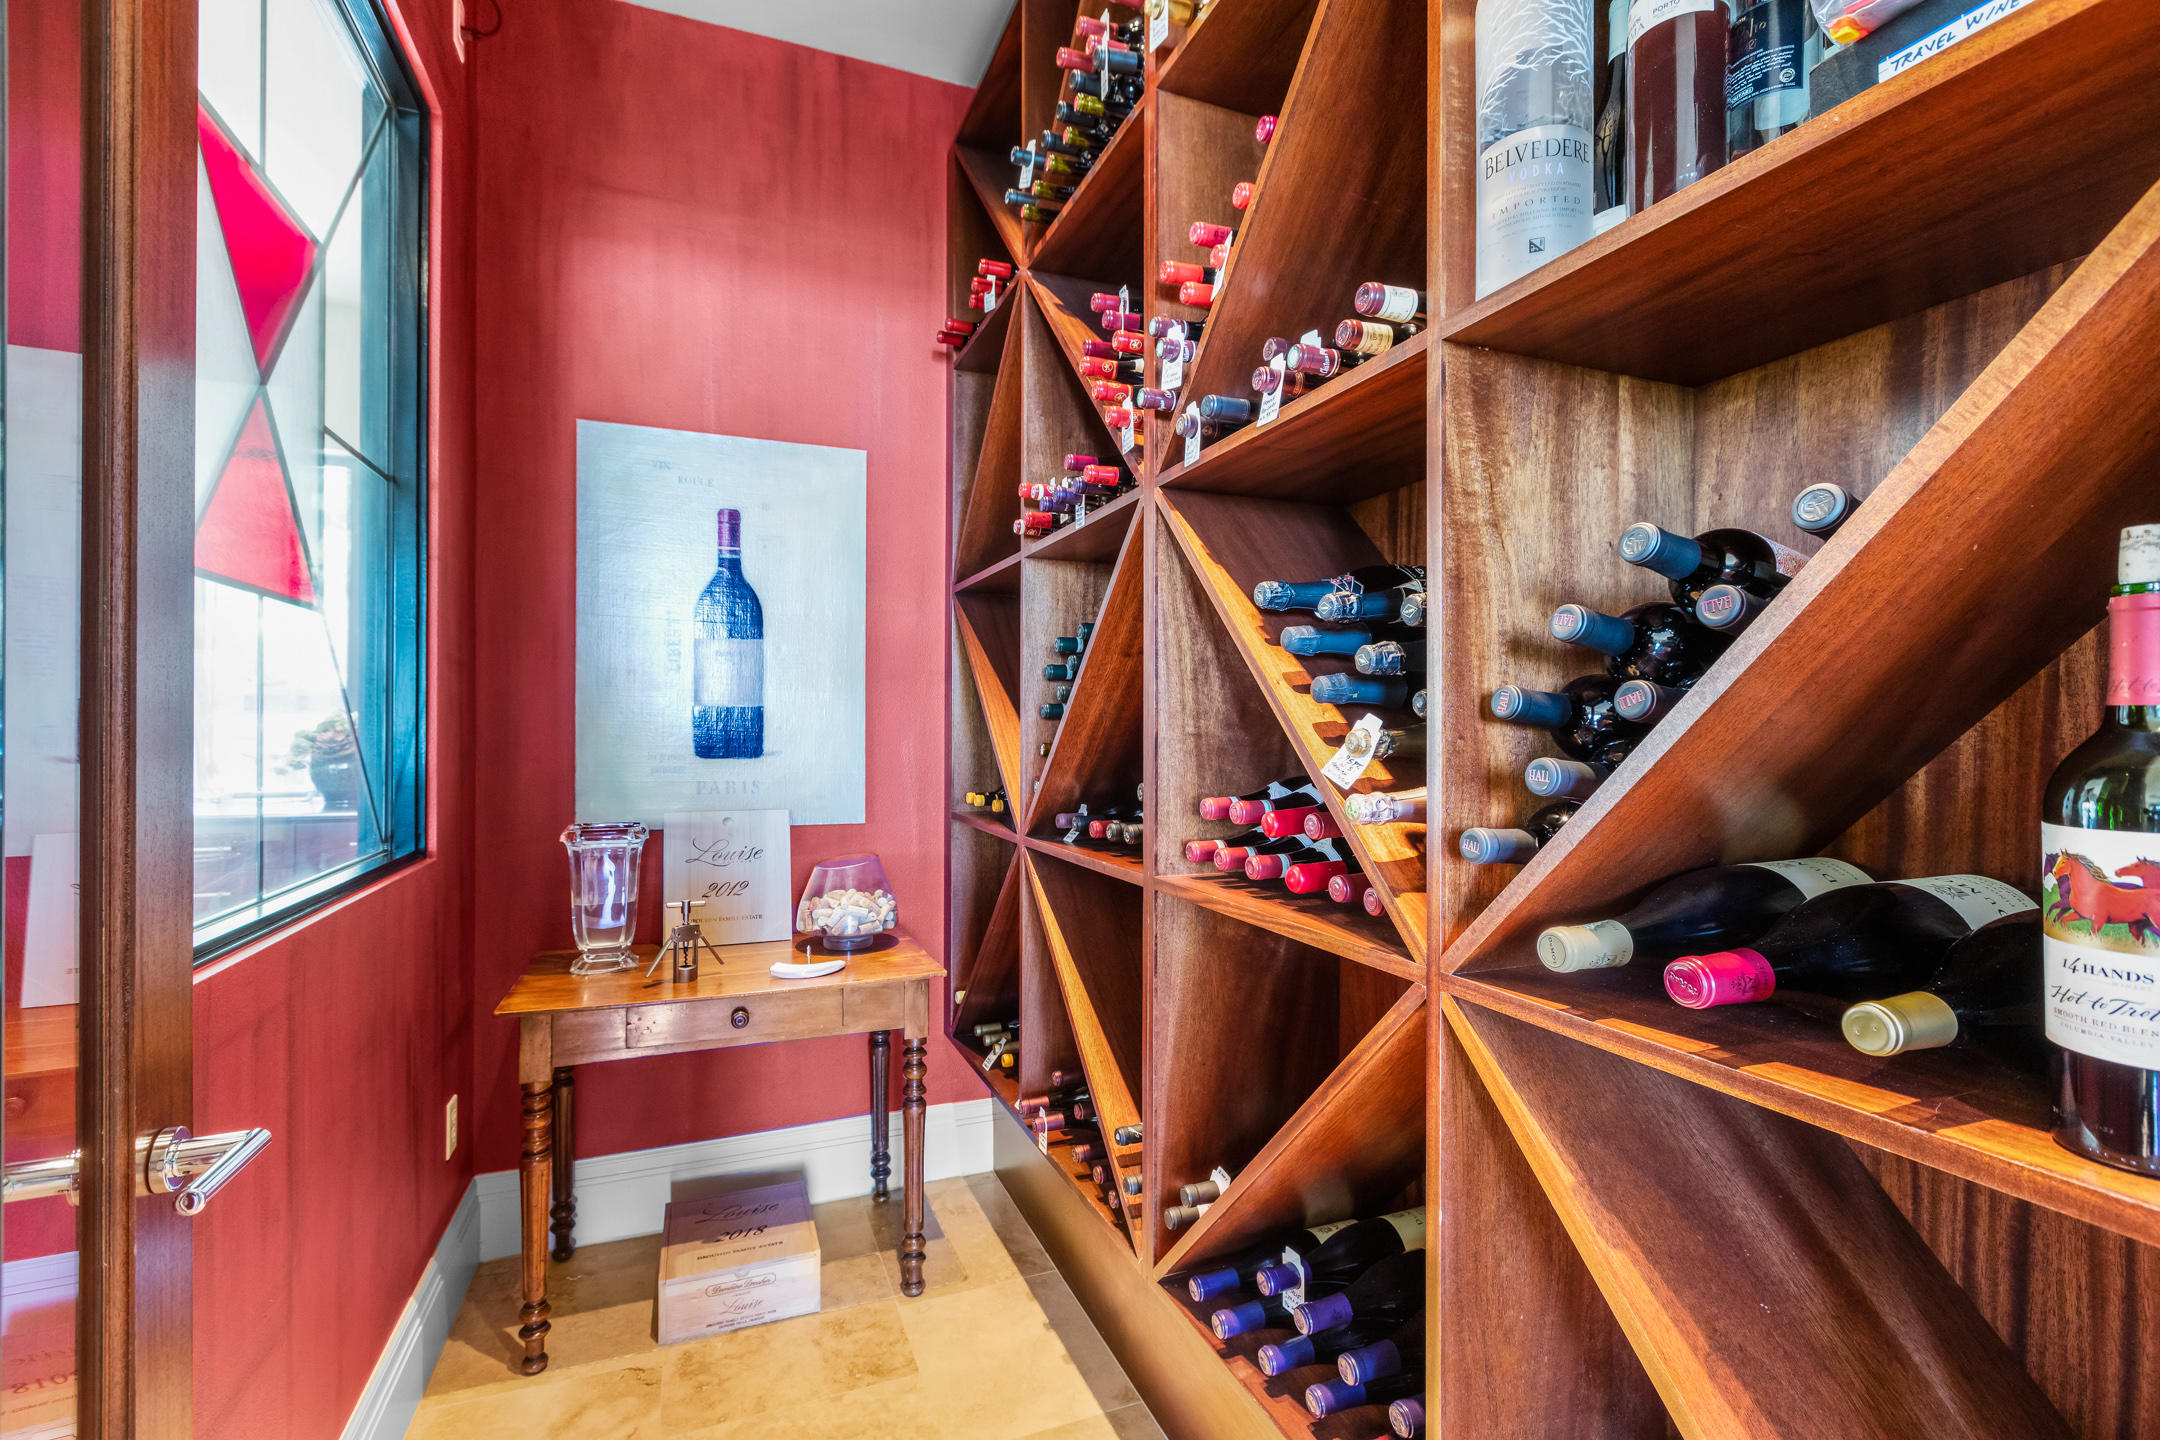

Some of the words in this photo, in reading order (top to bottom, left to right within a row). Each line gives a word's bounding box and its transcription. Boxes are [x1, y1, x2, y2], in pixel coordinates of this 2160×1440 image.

[1889, 31, 1957, 72] TRAVEL
[1484, 138, 1590, 181] BELVEDERE
[1508, 161, 1564, 182] VODKA
[1491, 195, 1582, 220] IMPORTED
[1699, 594, 1733, 614] HALL
[1554, 613, 1576, 627] HALL
[1496, 690, 1511, 714] HALL
[1616, 689, 1647, 710] HALL
[1528, 769, 1550, 783] HALL
[695, 779, 761, 796] PARIS
[685, 837, 764, 867] Louise
[1462, 839, 1481, 855] HALL
[702, 880, 750, 898] 2012
[2050, 984, 2089, 1004] Hot
[2053, 1007, 2088, 1025] SMOOTH
[2091, 1018, 2118, 1031] RED
[2121, 1025, 2160, 1038] BLEN
[695, 1202, 780, 1225] Louise
[712, 1224, 768, 1243] 2018
